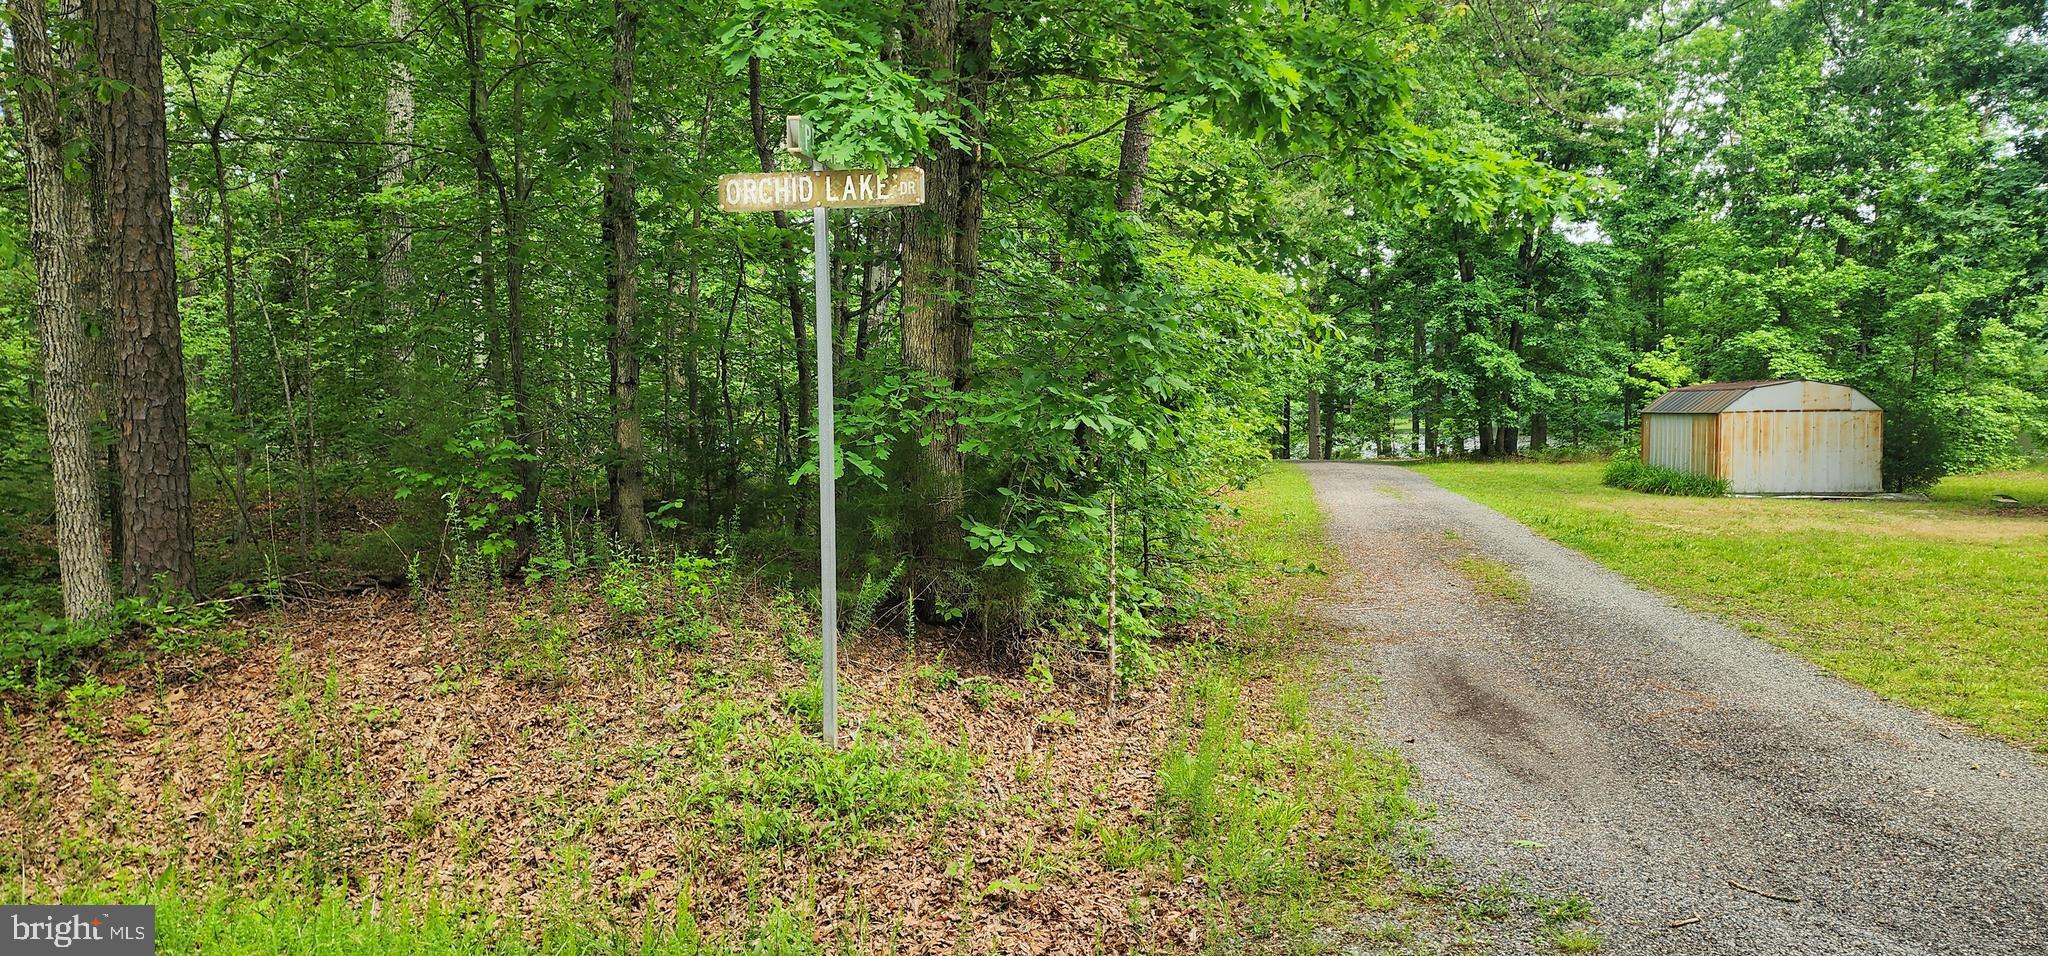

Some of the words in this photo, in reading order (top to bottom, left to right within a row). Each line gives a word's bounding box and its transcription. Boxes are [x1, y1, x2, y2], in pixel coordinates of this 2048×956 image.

[726, 175, 813, 205] ORCHID
[825, 174, 889, 202] LAKE
[899, 181, 916, 195] DR
